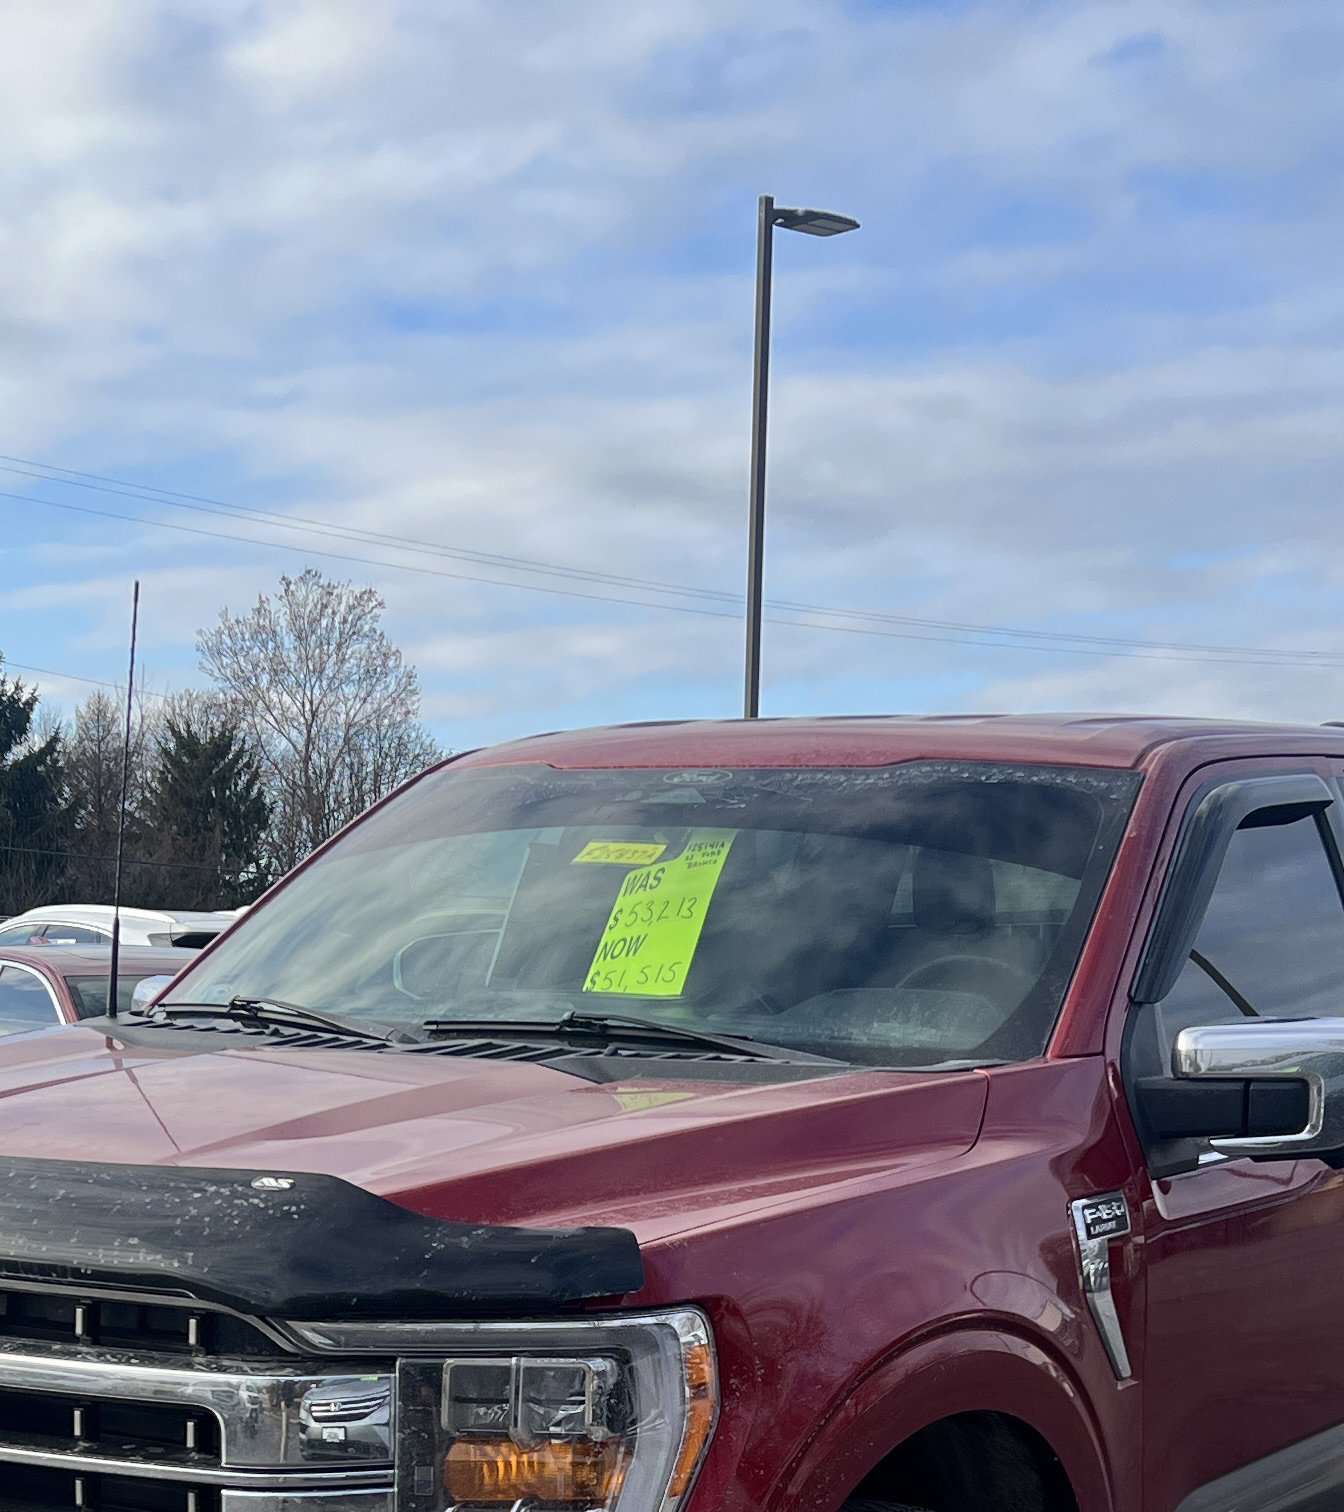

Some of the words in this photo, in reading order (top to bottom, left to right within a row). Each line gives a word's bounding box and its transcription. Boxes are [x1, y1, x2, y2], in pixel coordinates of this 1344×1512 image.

[622, 867, 666, 897] WAS
[596, 933, 648, 963] NOW
[1084, 1201, 1125, 1223] F-150
